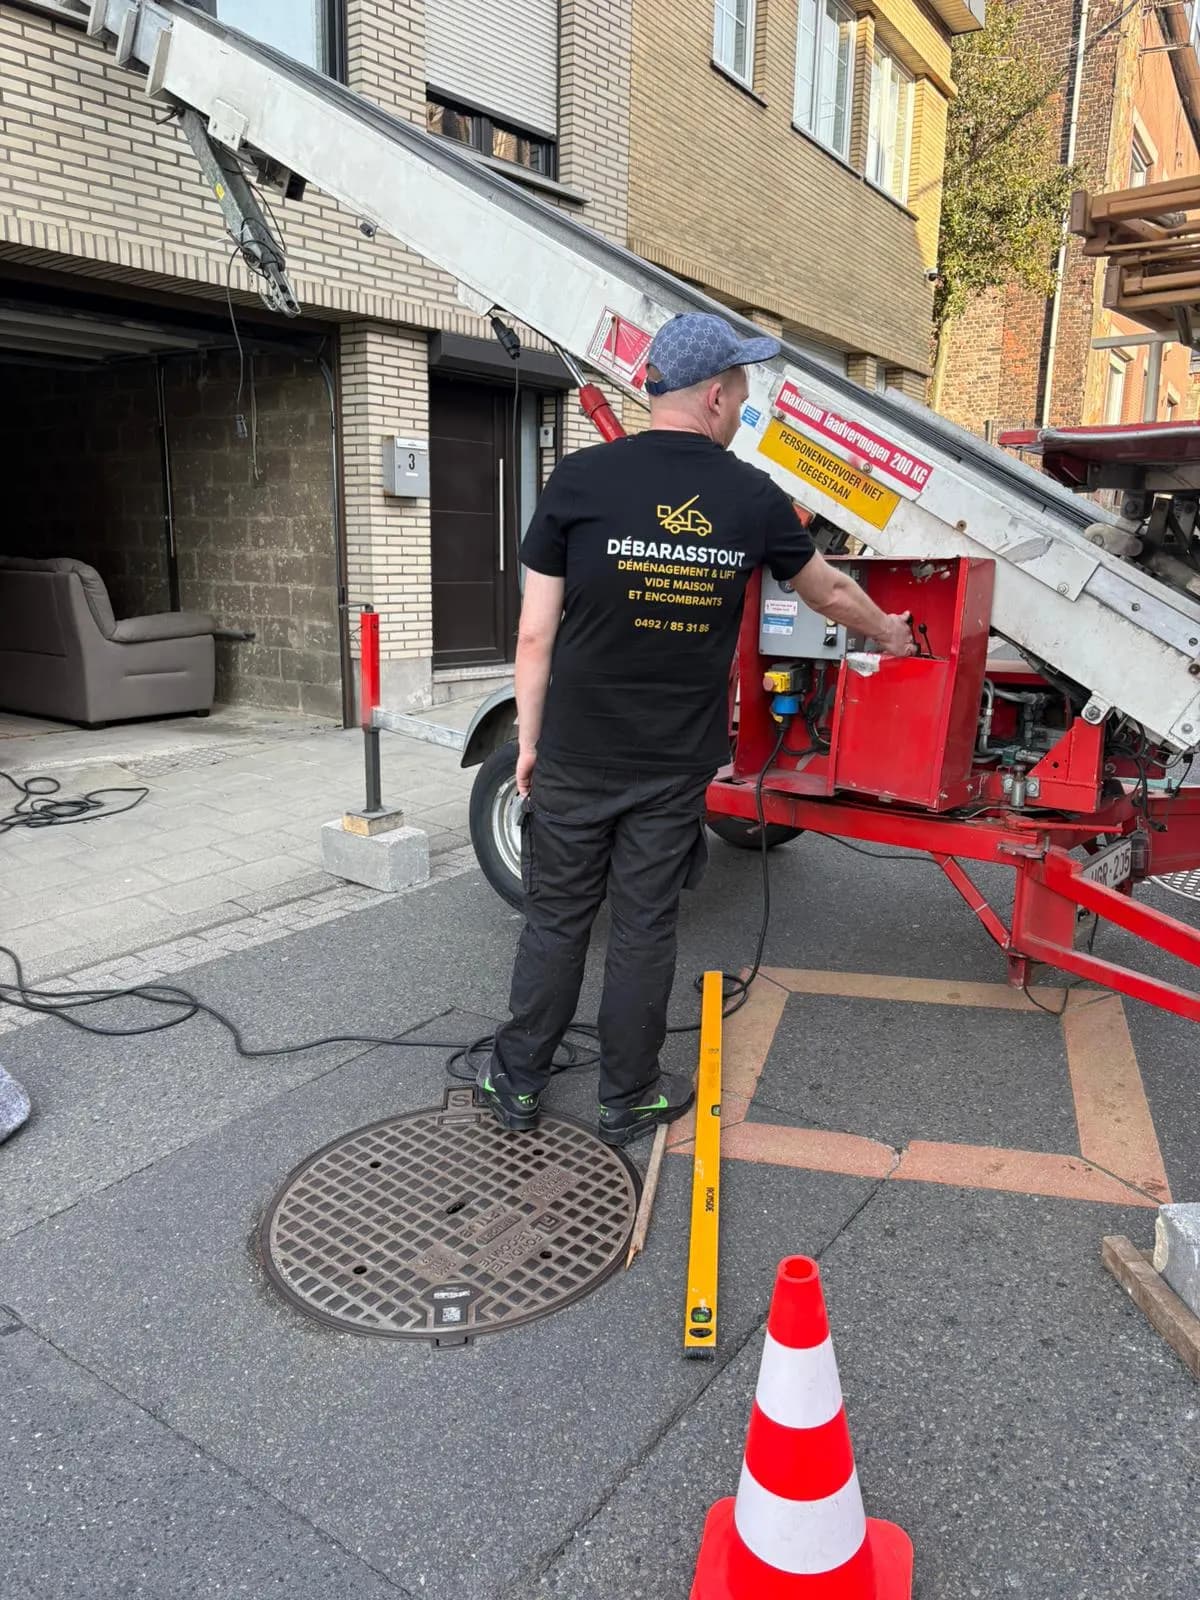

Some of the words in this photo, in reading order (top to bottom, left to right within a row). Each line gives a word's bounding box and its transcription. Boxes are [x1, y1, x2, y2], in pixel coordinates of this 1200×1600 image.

[780, 388, 824, 423] maximum
[824, 412, 891, 464] laadvermogen
[889, 450, 912, 476] 200
[909, 465, 928, 485] KG
[408, 453, 416, 470] 3
[779, 430, 862, 488] PERSONENVERVOER
[861, 482, 884, 502] NIET
[796, 458, 852, 500] TOEGESTAAN
[607, 536, 745, 567] DÉBARASSTOUT
[618, 559, 709, 578] DÉMÉNAGEMENT
[710, 568, 718, 579] &
[719, 570, 736, 580] LIFT
[645, 577, 670, 589] VIDE
[673, 580, 714, 592] MAISON
[628, 590, 642, 600] ET
[645, 592, 722, 607] ENCOMBRANTS
[634, 618, 661, 629] 0492
